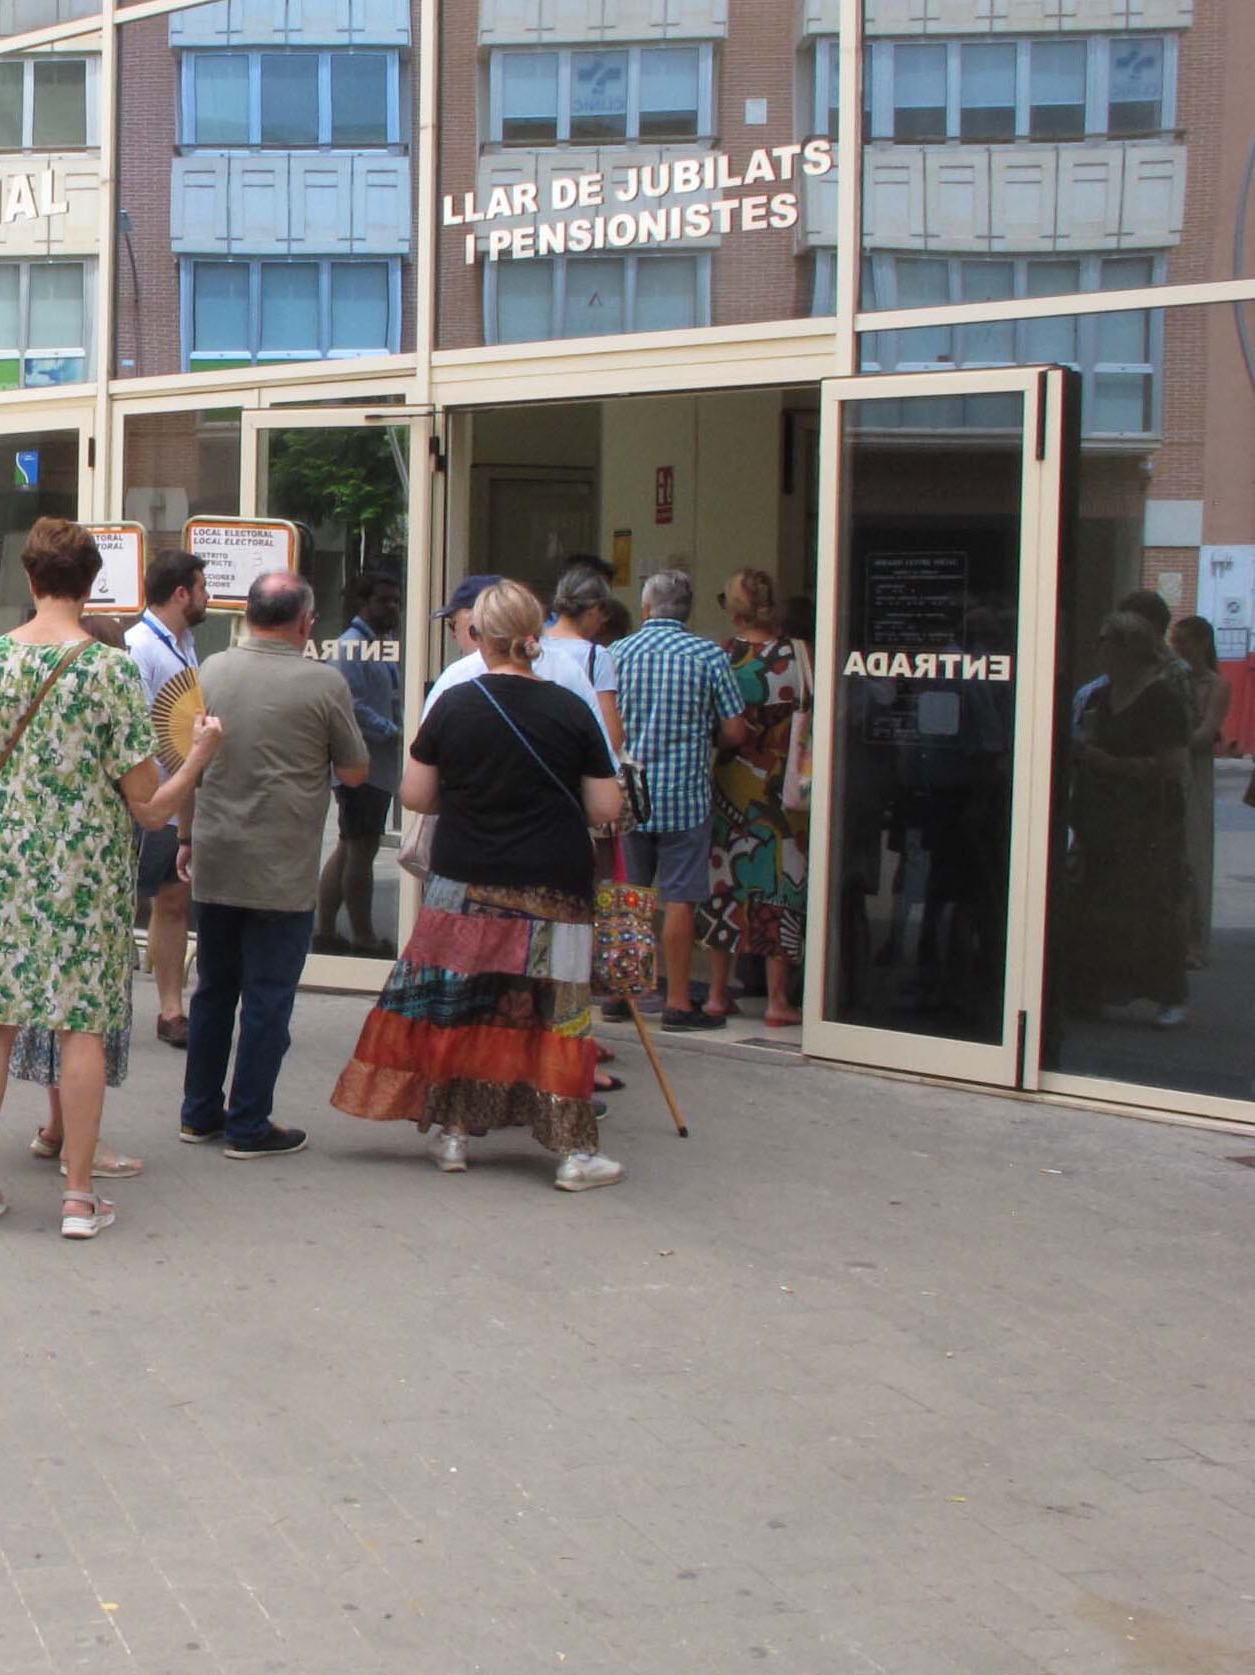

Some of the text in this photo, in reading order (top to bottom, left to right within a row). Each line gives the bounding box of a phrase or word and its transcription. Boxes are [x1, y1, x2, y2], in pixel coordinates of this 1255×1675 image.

[443, 139, 833, 227] LLAR DE JUBILATS
[465, 192, 799, 265] I PENSIONISTES
[193, 528, 274, 538] LOCAL ELECTORAL
[193, 537, 275, 547] LOCAL ELECTORAL
